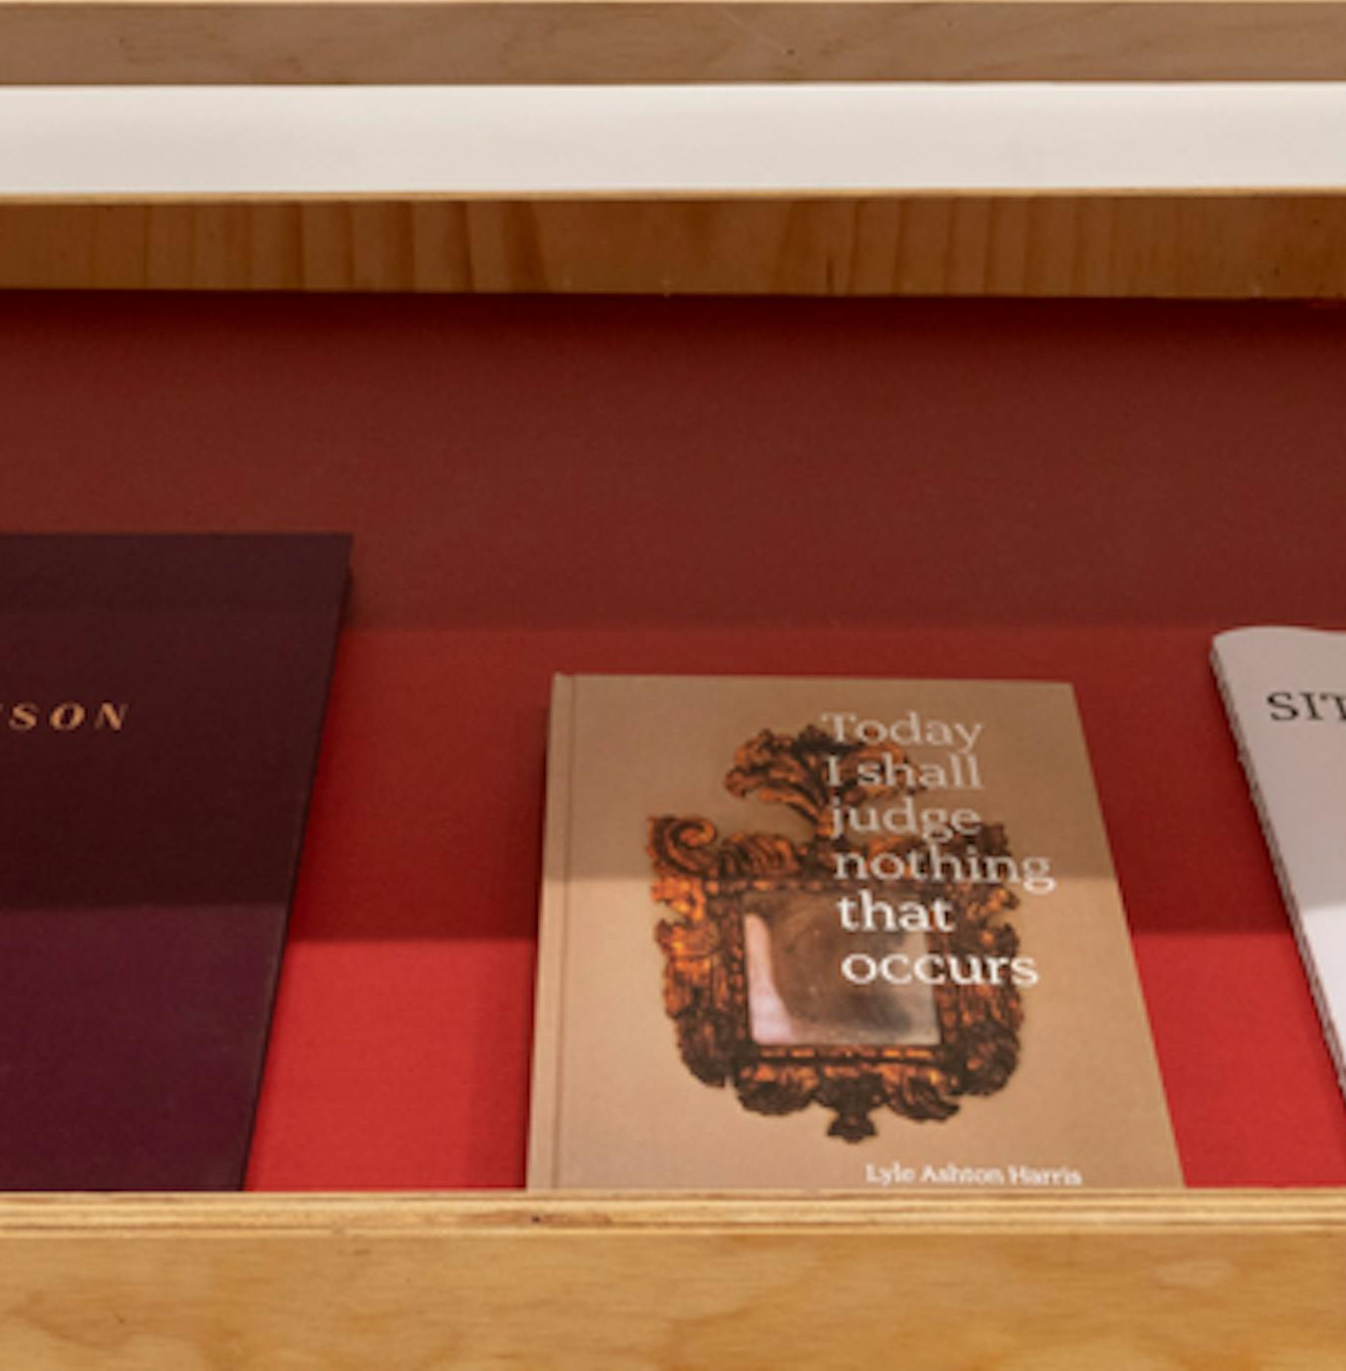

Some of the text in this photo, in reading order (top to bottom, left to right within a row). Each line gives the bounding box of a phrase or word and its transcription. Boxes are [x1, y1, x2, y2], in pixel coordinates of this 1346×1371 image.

[821, 710, 985, 754] Today
[826, 752, 986, 790] I shall
[828, 795, 983, 843] judge
[832, 841, 1058, 895] nothing
[836, 888, 957, 932] that
[840, 952, 1040, 989] occurs
[864, 1161, 1083, 1187] Lyle Ashton Harris
